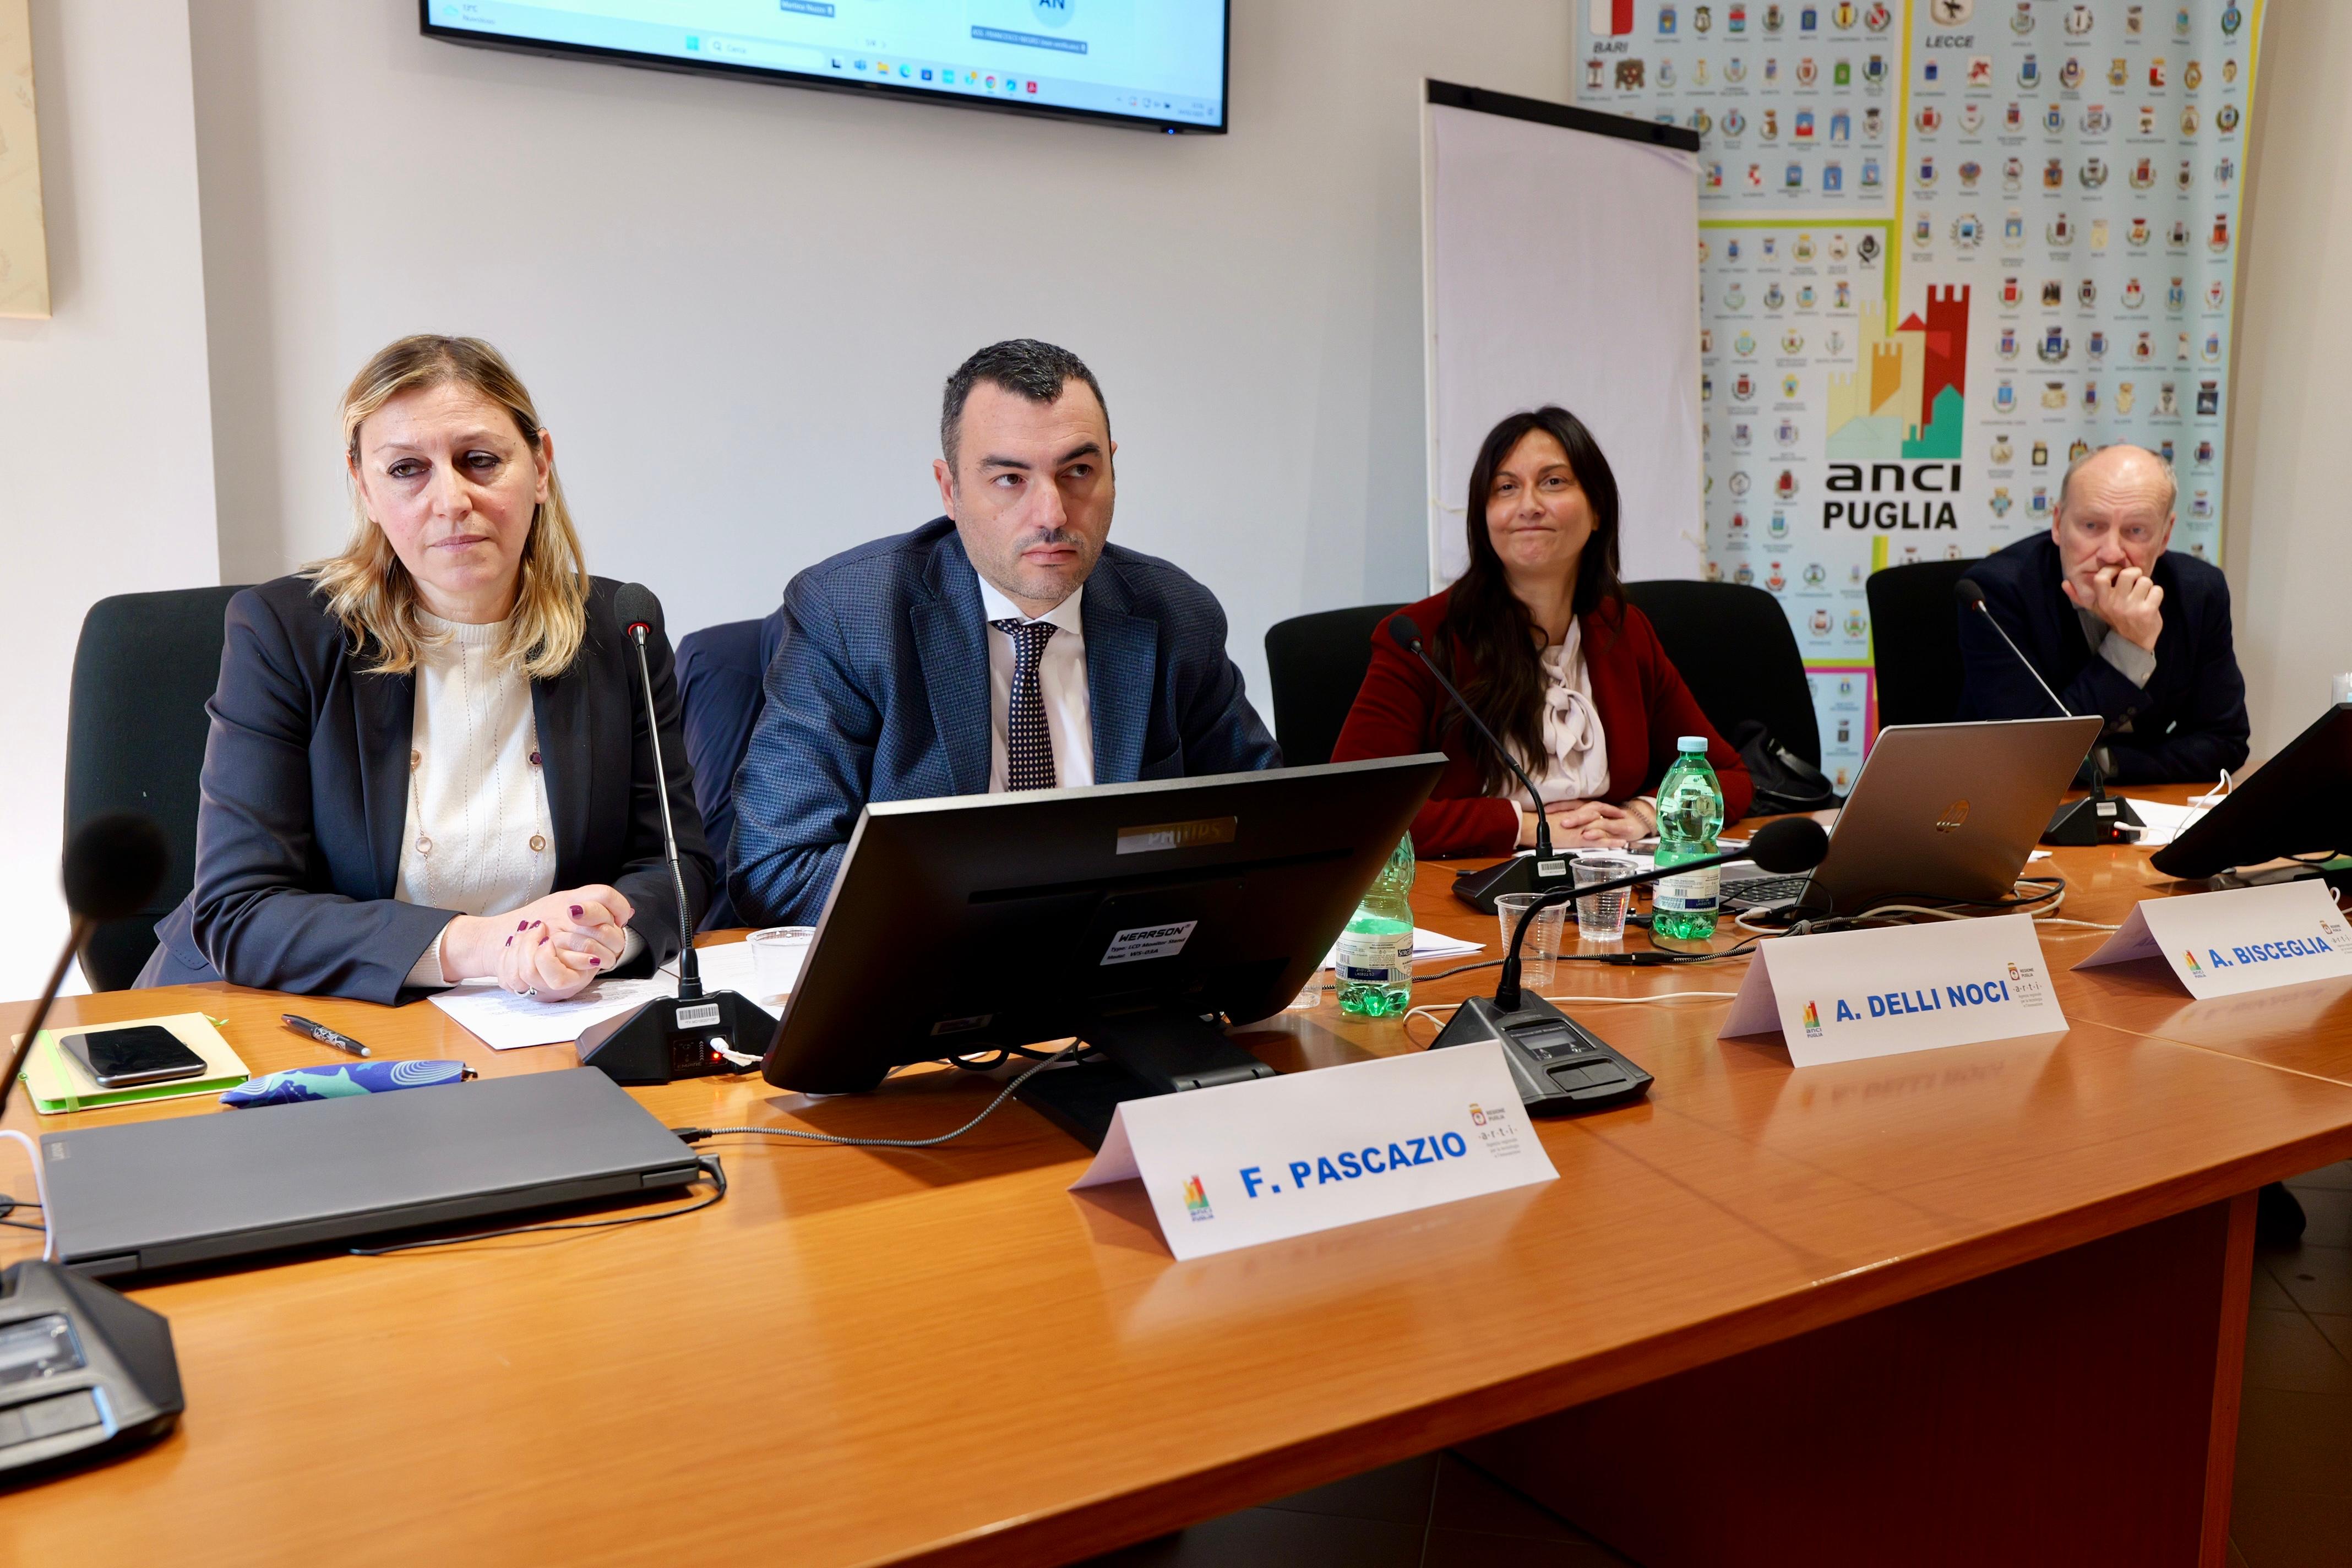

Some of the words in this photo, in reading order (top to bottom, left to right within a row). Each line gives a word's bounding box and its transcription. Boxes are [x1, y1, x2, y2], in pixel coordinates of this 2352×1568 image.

[1593, 40, 1629, 53] BARI
[1926, 35, 1974, 48] LECCE
[1826, 464, 1962, 492] anci
[1823, 501, 1958, 530] PUGLIA
[2208, 949, 2234, 968] A.
[2232, 937, 2334, 965] BISCEGLIA
[1836, 999, 1861, 1022] A.
[1867, 988, 1941, 1017] DELLI
[1946, 980, 2010, 1008] NOCI
[1239, 1166, 1281, 1199] F.
[1288, 1131, 1467, 1189] PASCAZIO
